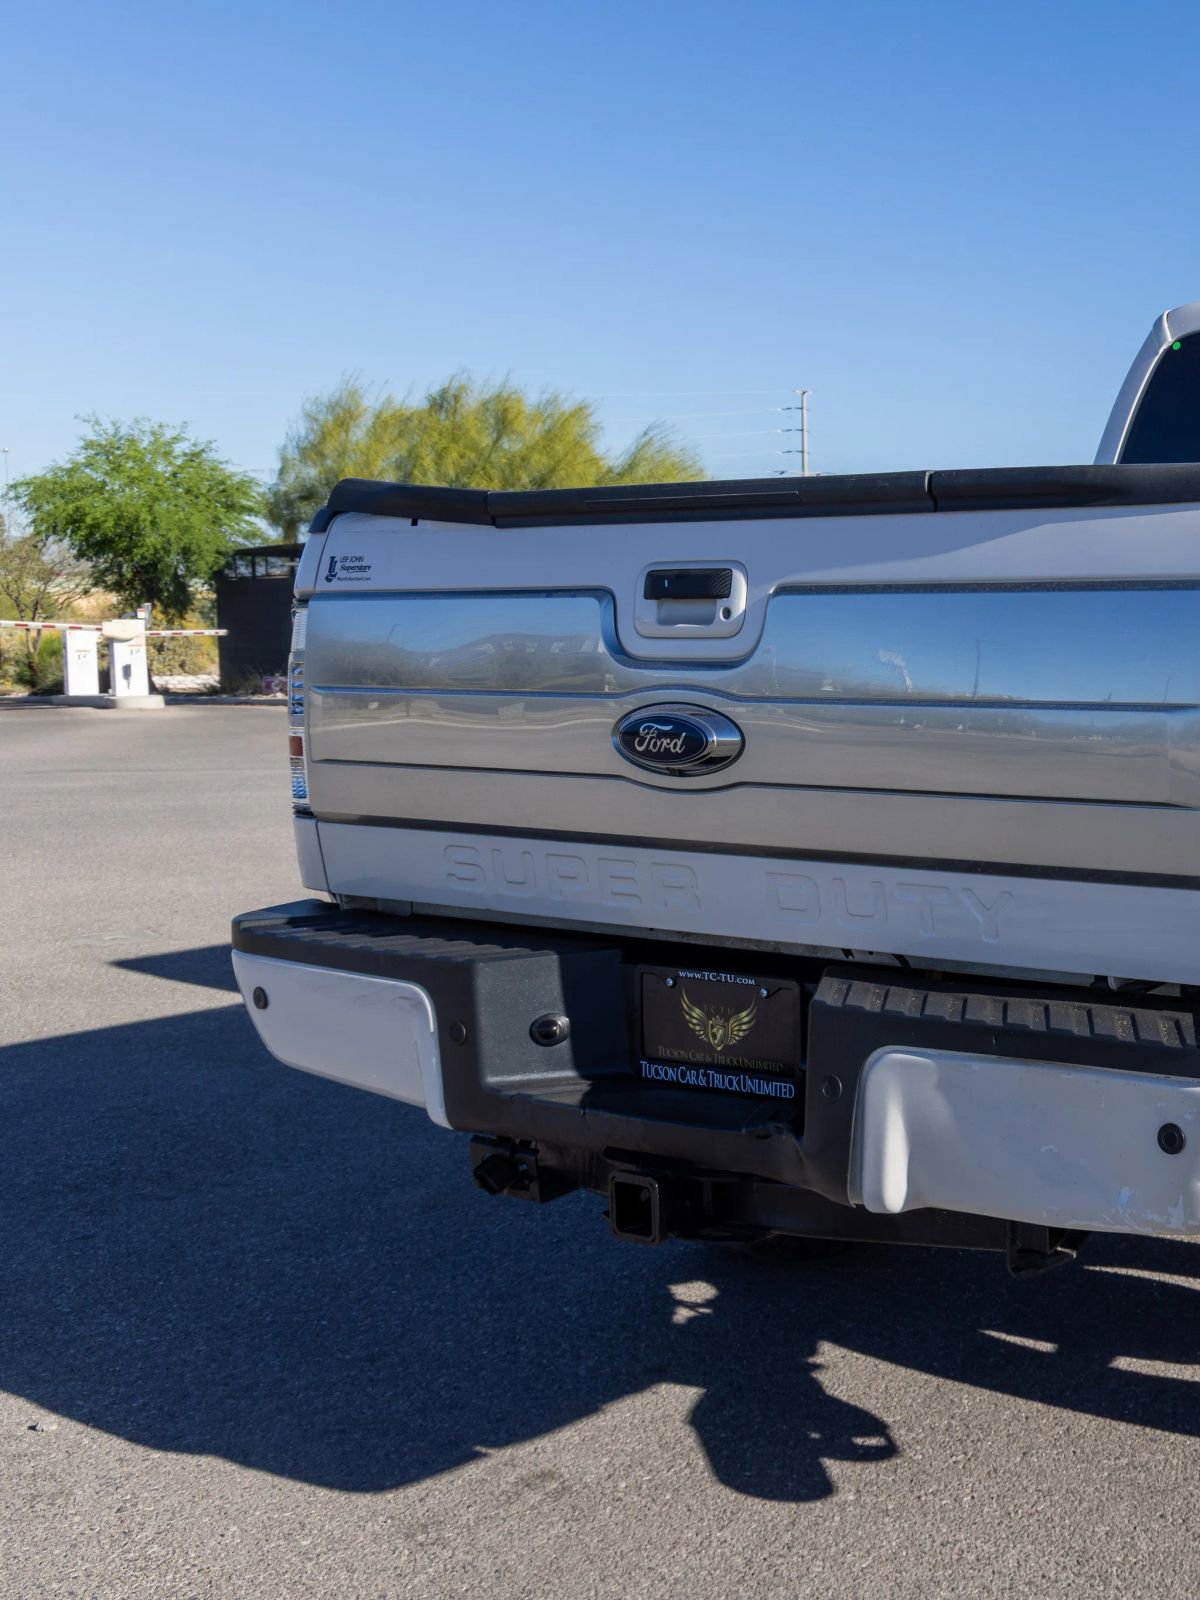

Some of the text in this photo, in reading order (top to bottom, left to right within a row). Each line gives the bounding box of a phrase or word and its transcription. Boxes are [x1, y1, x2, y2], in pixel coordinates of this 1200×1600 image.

[634, 722, 687, 754] Ford
[444, 844, 1015, 944] SUPER DUTY
[698, 1069, 707, 1087] &
